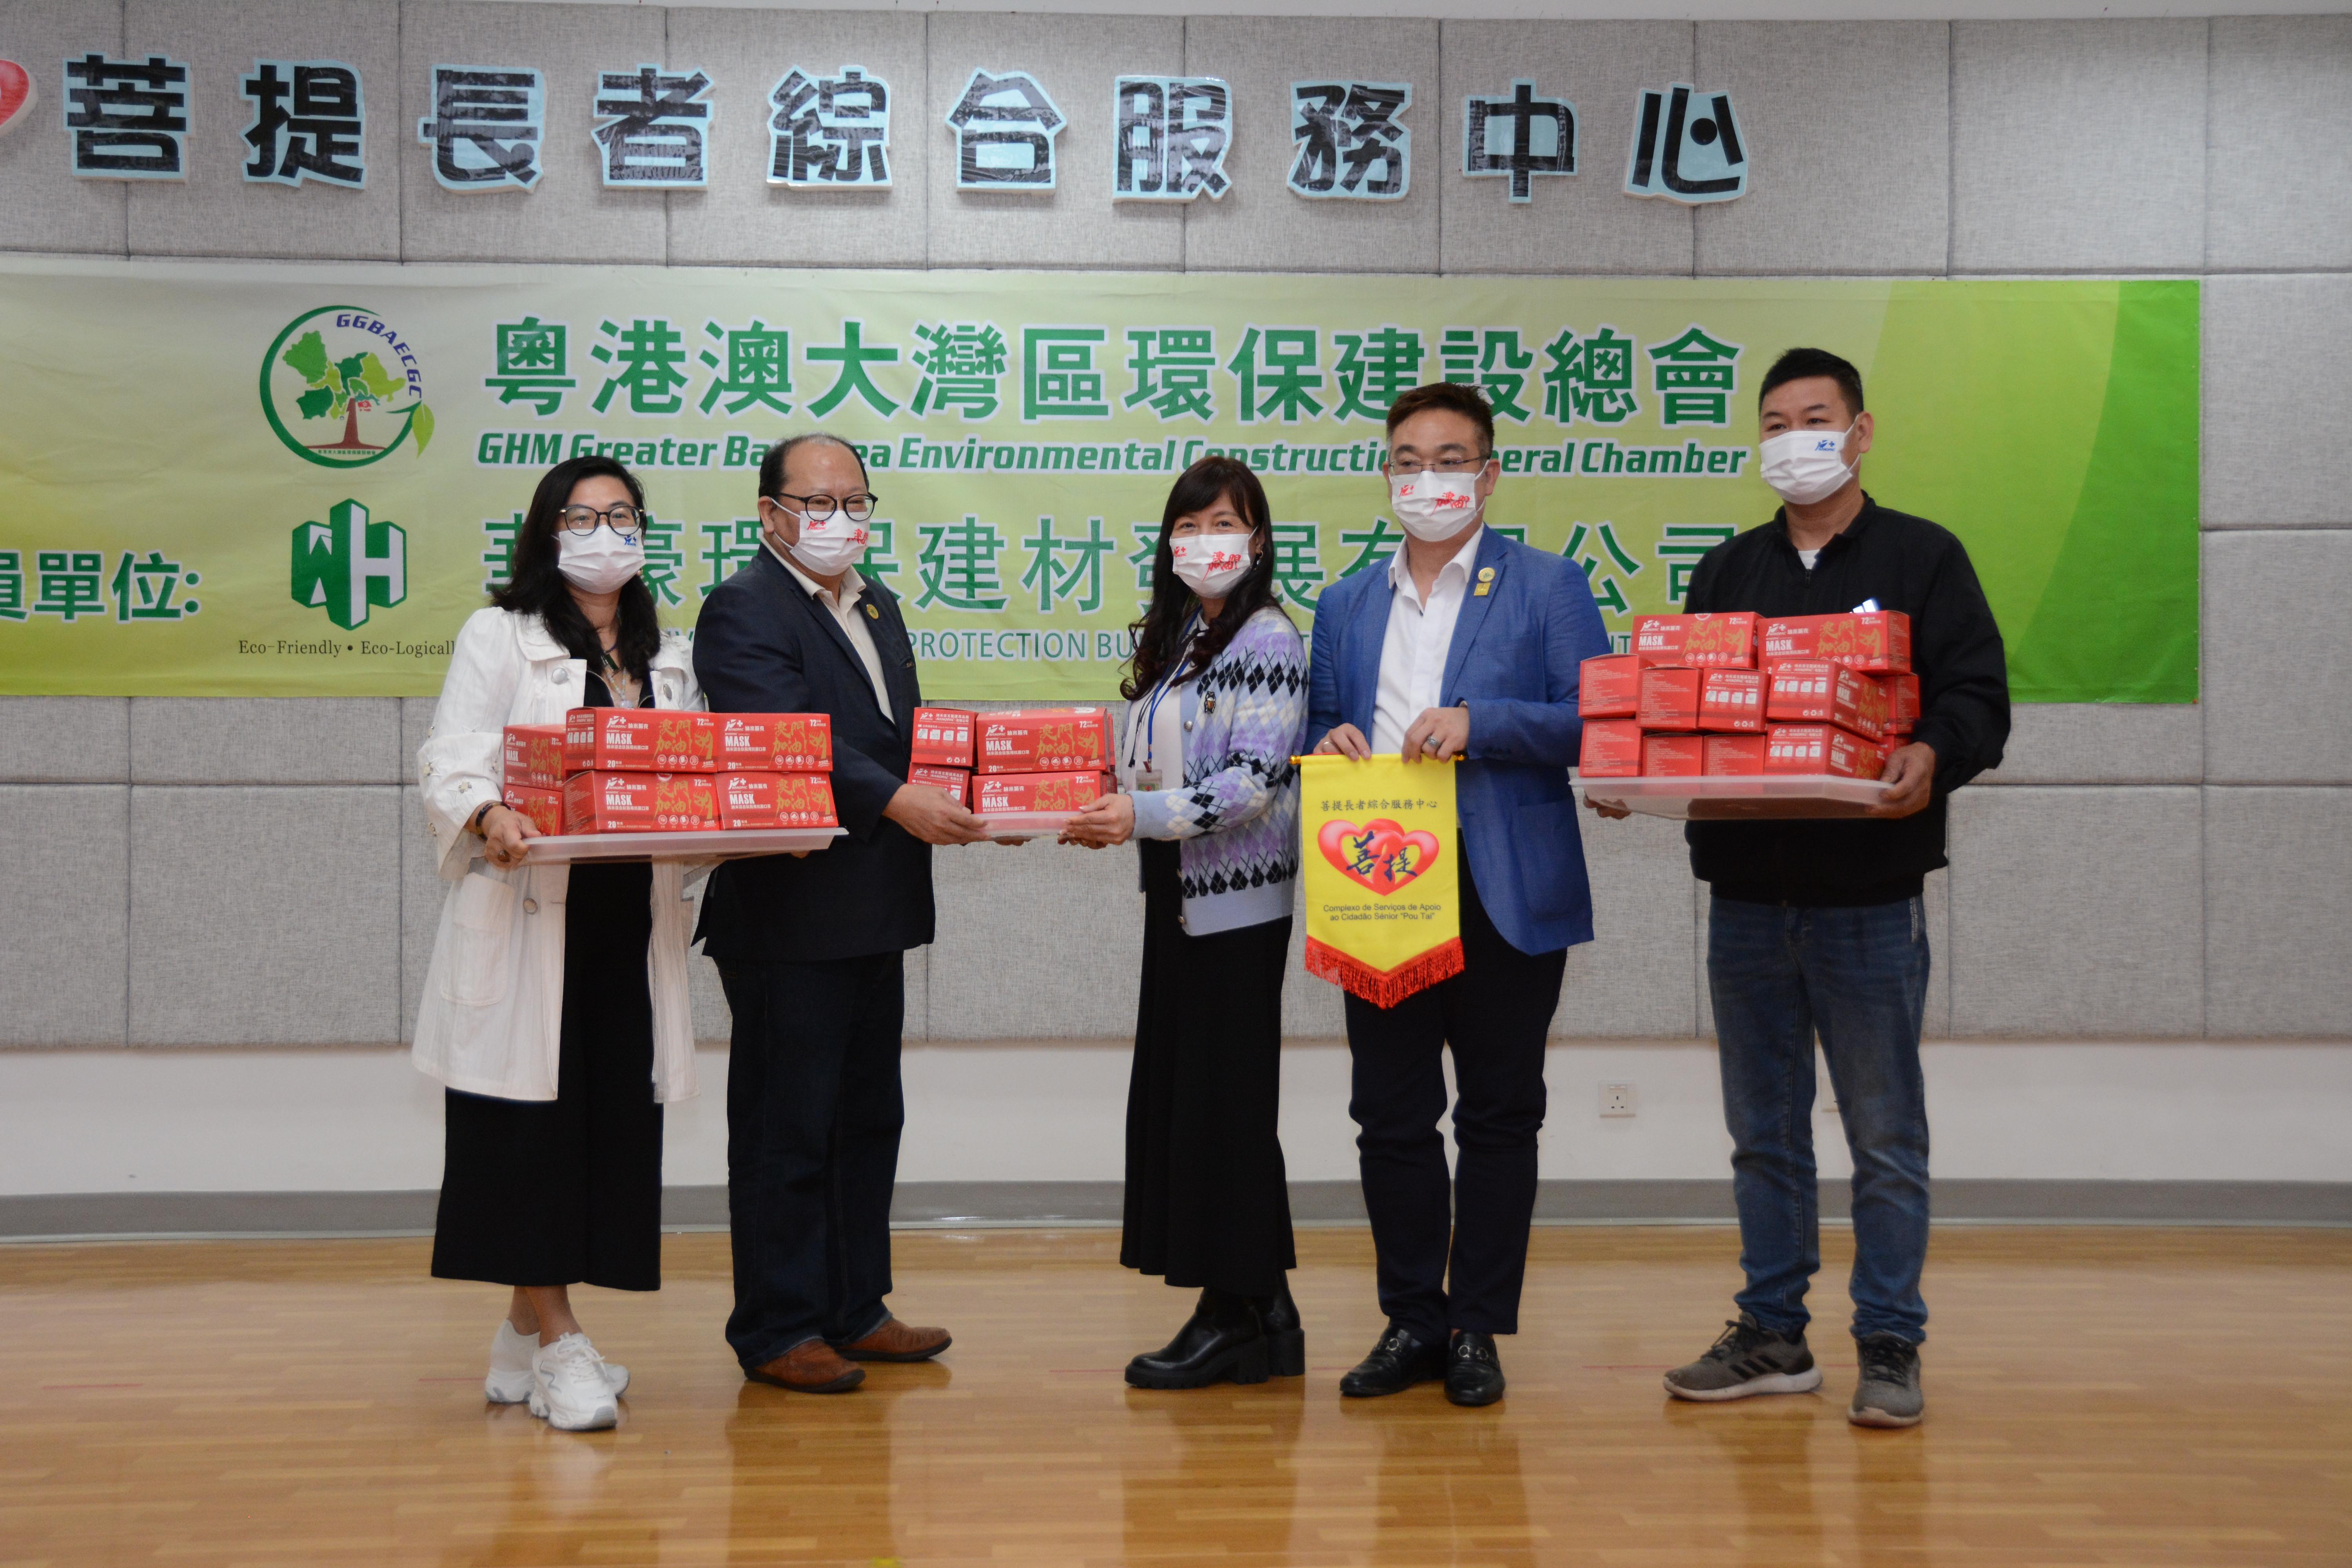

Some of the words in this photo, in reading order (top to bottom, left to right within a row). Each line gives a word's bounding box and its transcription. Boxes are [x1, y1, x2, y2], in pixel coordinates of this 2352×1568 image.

[64, 54, 1746, 198] 菩提長者綜合服務中心
[336, 314, 422, 398] GGBAECGC
[485, 317, 1739, 425] 粵港澳大灣區環保建設總會
[478, 433, 563, 464] GHM
[569, 434, 717, 466] Greater
[899, 438, 1176, 470] Environmental
[1582, 443, 1746, 474] Chamber
[1639, 635, 1663, 646] MASK
[1766, 639, 1792, 652] MASK
[239, 640, 342, 658] Eco-Friendly
[606, 733, 632, 745] MASK
[725, 736, 750, 747] MASK
[986, 740, 1013, 751] MASK
[506, 750, 519, 762] MASK
[606, 794, 632, 806] MASK
[729, 793, 755, 805] MASK
[982, 796, 1009, 808] MASK
[1320, 798, 1437, 811] 菩提長者綜合服務中心
[1346, 830, 1418, 882] 菩提
[1374, 903, 1406, 911] Serviços
[1419, 903, 1441, 911] Apoio
